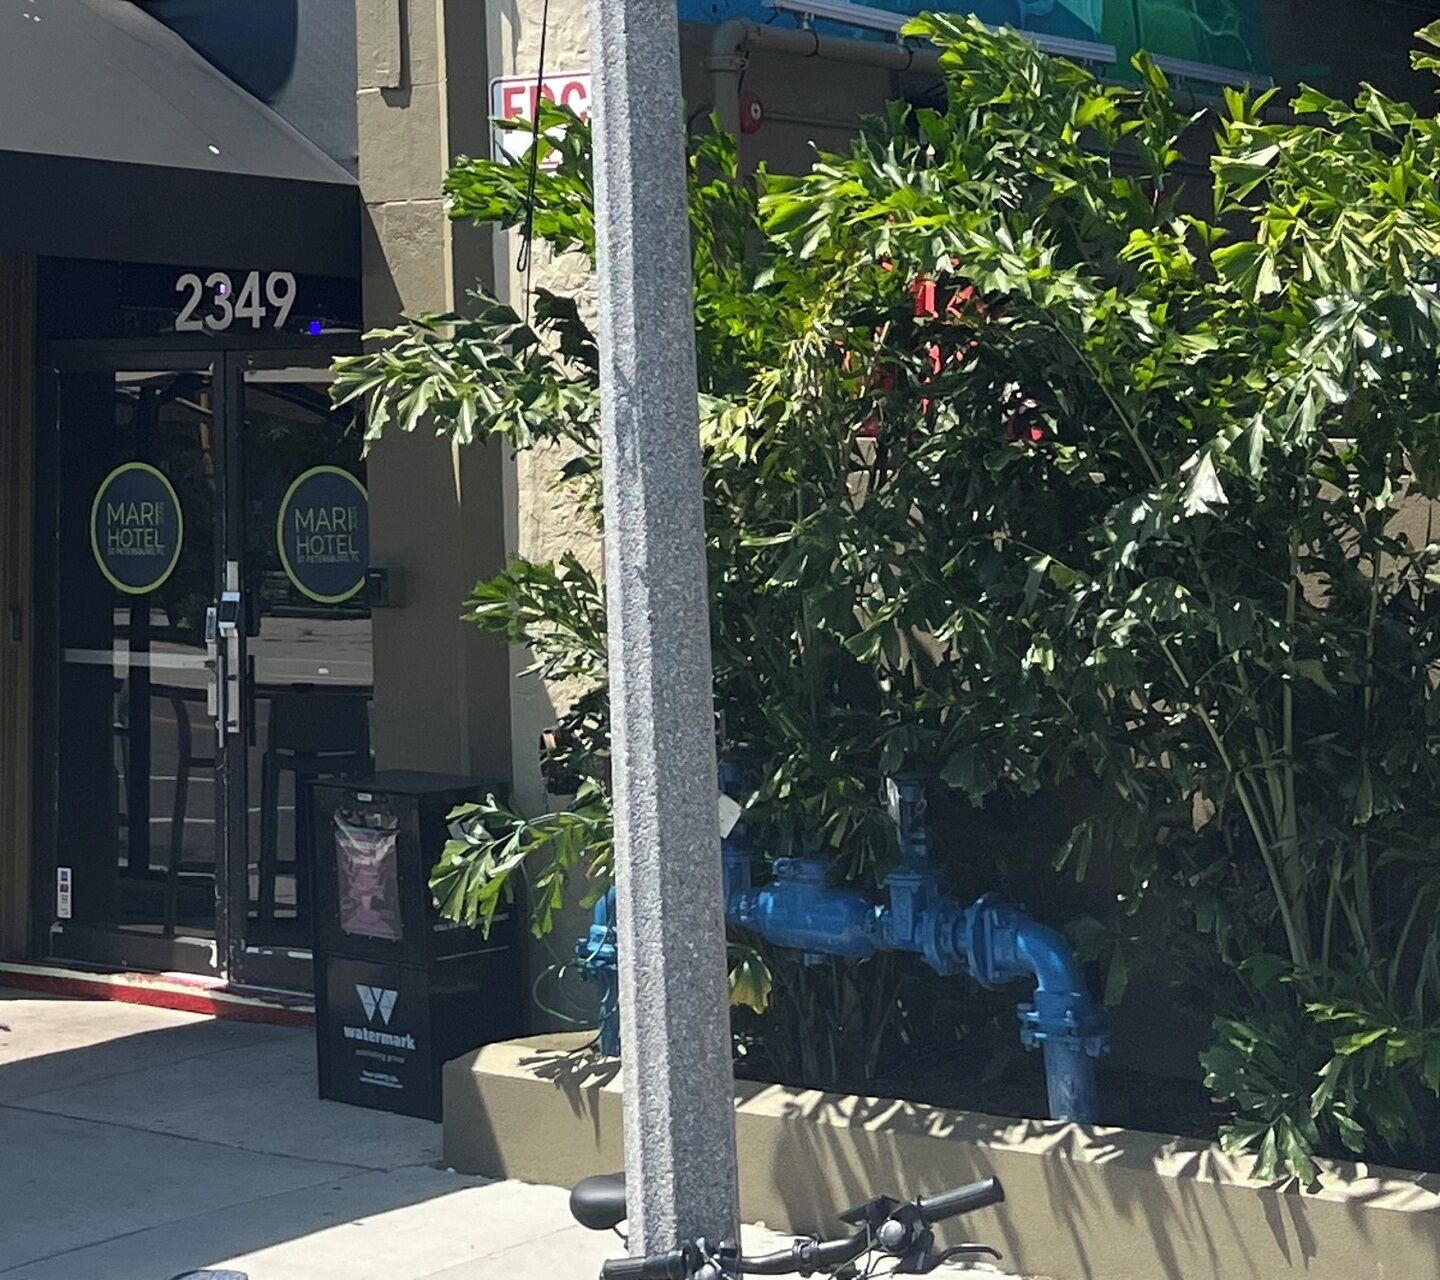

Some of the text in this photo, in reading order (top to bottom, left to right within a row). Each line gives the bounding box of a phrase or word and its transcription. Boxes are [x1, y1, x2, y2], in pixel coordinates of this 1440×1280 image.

[174, 270, 297, 332] 2349
[106, 501, 160, 527] MARI
[295, 506, 353, 533] MARI
[107, 527, 166, 549] HOTEL
[296, 533, 360, 556] HOTEL
[343, 1025, 416, 1051] watermark
